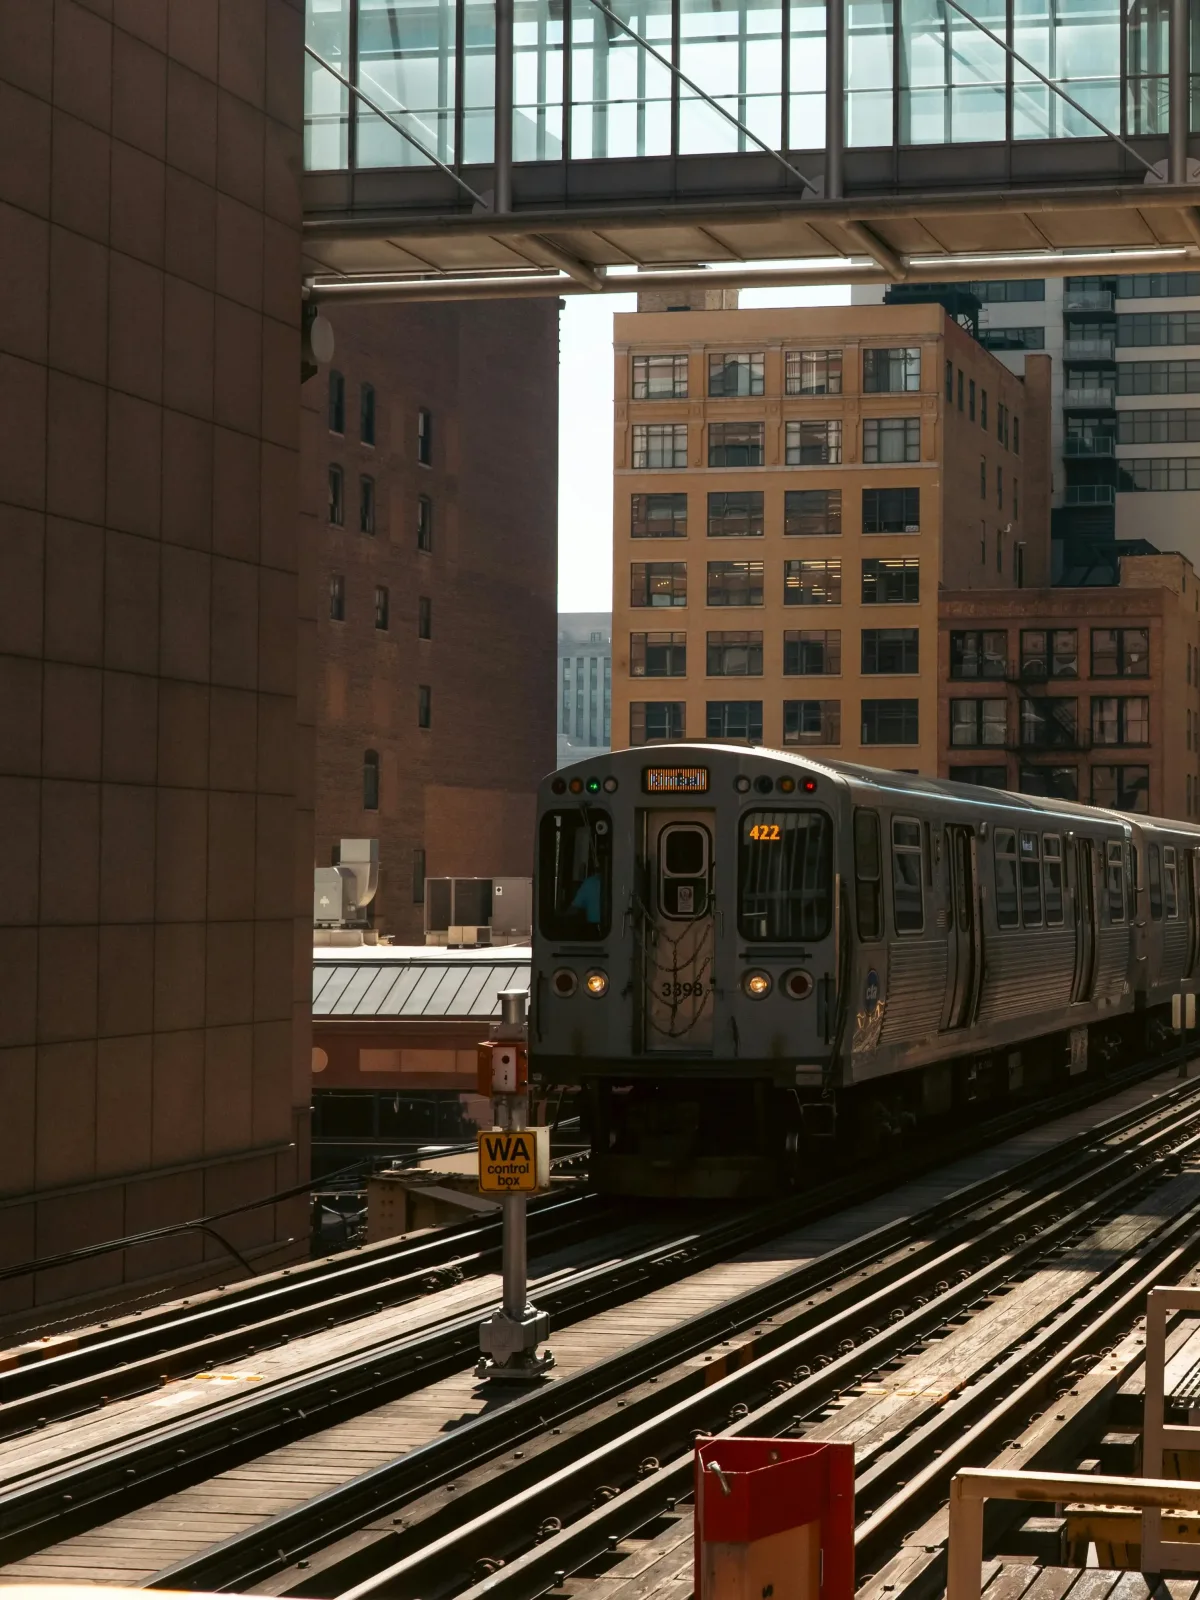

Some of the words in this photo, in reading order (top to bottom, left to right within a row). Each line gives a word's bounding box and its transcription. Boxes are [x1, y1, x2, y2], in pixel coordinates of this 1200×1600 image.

[650, 772, 705, 786] Kimball
[750, 825, 780, 840] 422
[662, 983, 703, 997] 3398
[485, 1138, 531, 1161] WA
[487, 1163, 530, 1174] control
[497, 1175, 520, 1186] box
